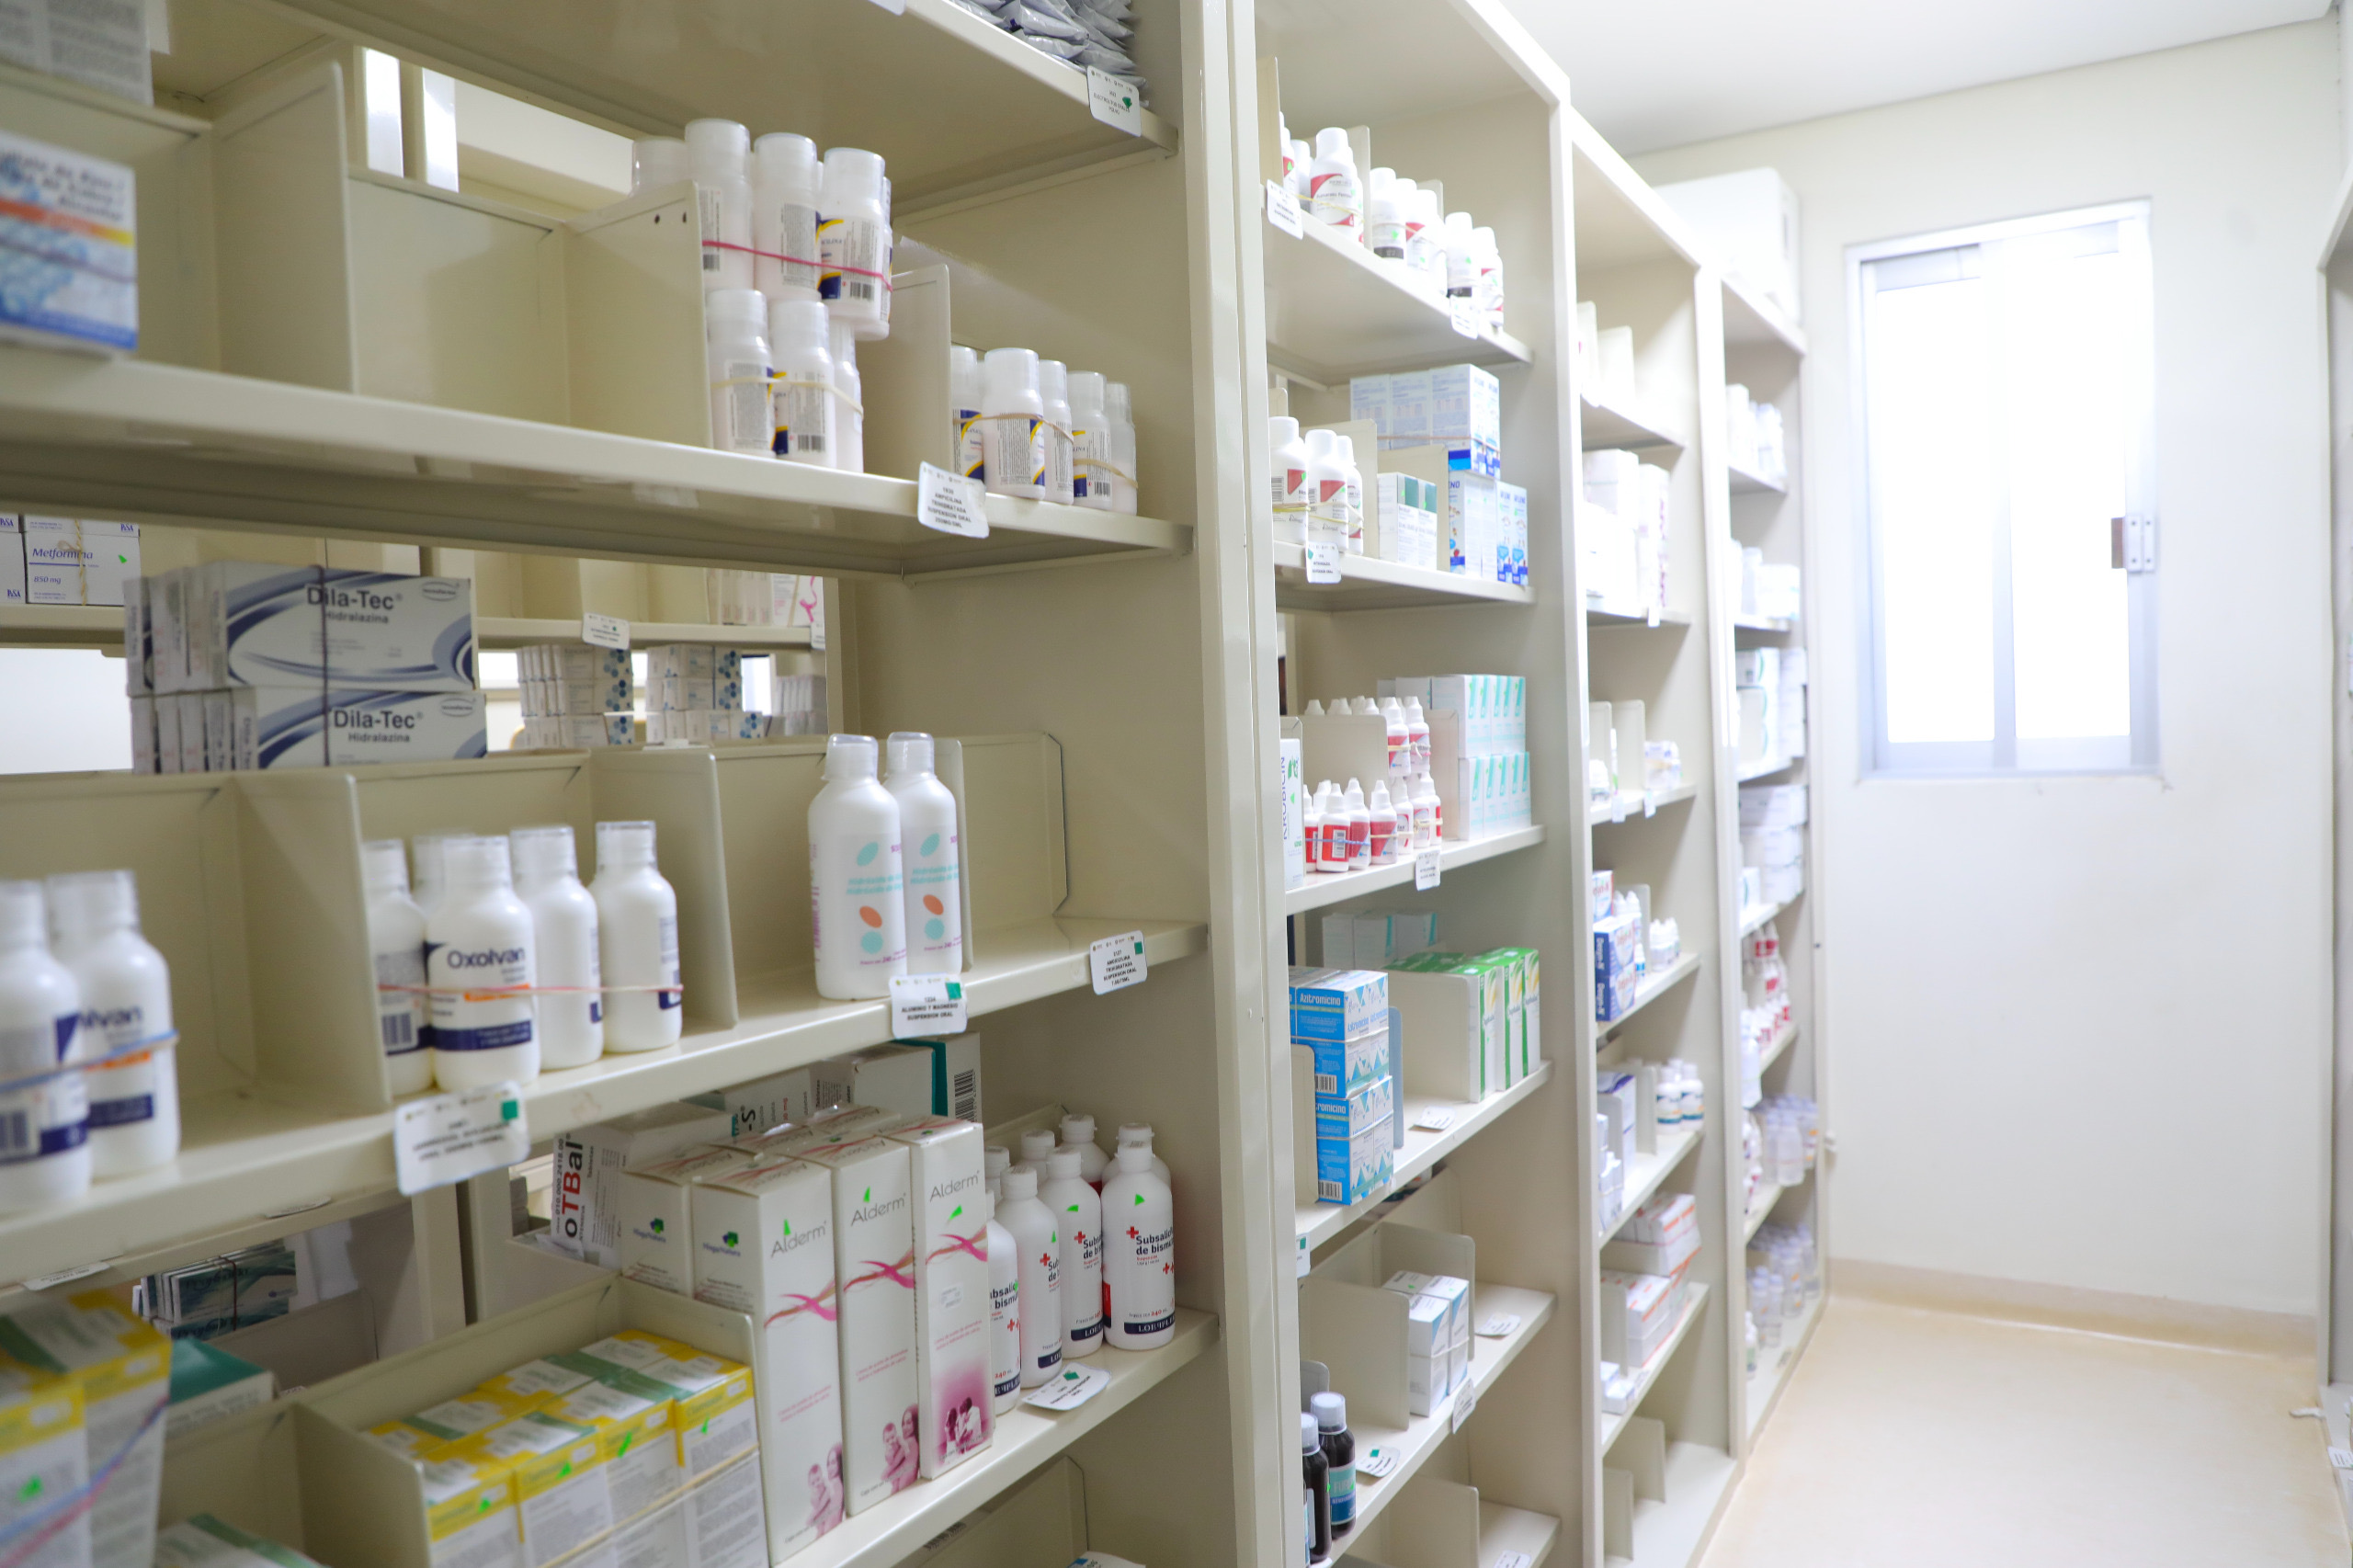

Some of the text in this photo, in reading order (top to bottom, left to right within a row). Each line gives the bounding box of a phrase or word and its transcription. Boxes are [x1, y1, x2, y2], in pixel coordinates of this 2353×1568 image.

[307, 586, 394, 610] Dila-Tec
[325, 610, 389, 624] Hidralazina
[334, 710, 415, 729] Dila-Tec
[348, 733, 410, 743] Hidralazina
[448, 948, 526, 969] Oxolvan
[1300, 993, 1341, 1006] Azitromicina
[929, 1176, 979, 1202] Alderm
[851, 1197, 905, 1226] Alderm
[770, 1224, 825, 1258] Alderm
[1084, 1251, 1093, 1259] de
[1136, 1245, 1148, 1256] de
[1048, 1272, 1057, 1282] de
[995, 1370, 1006, 1379] 240
